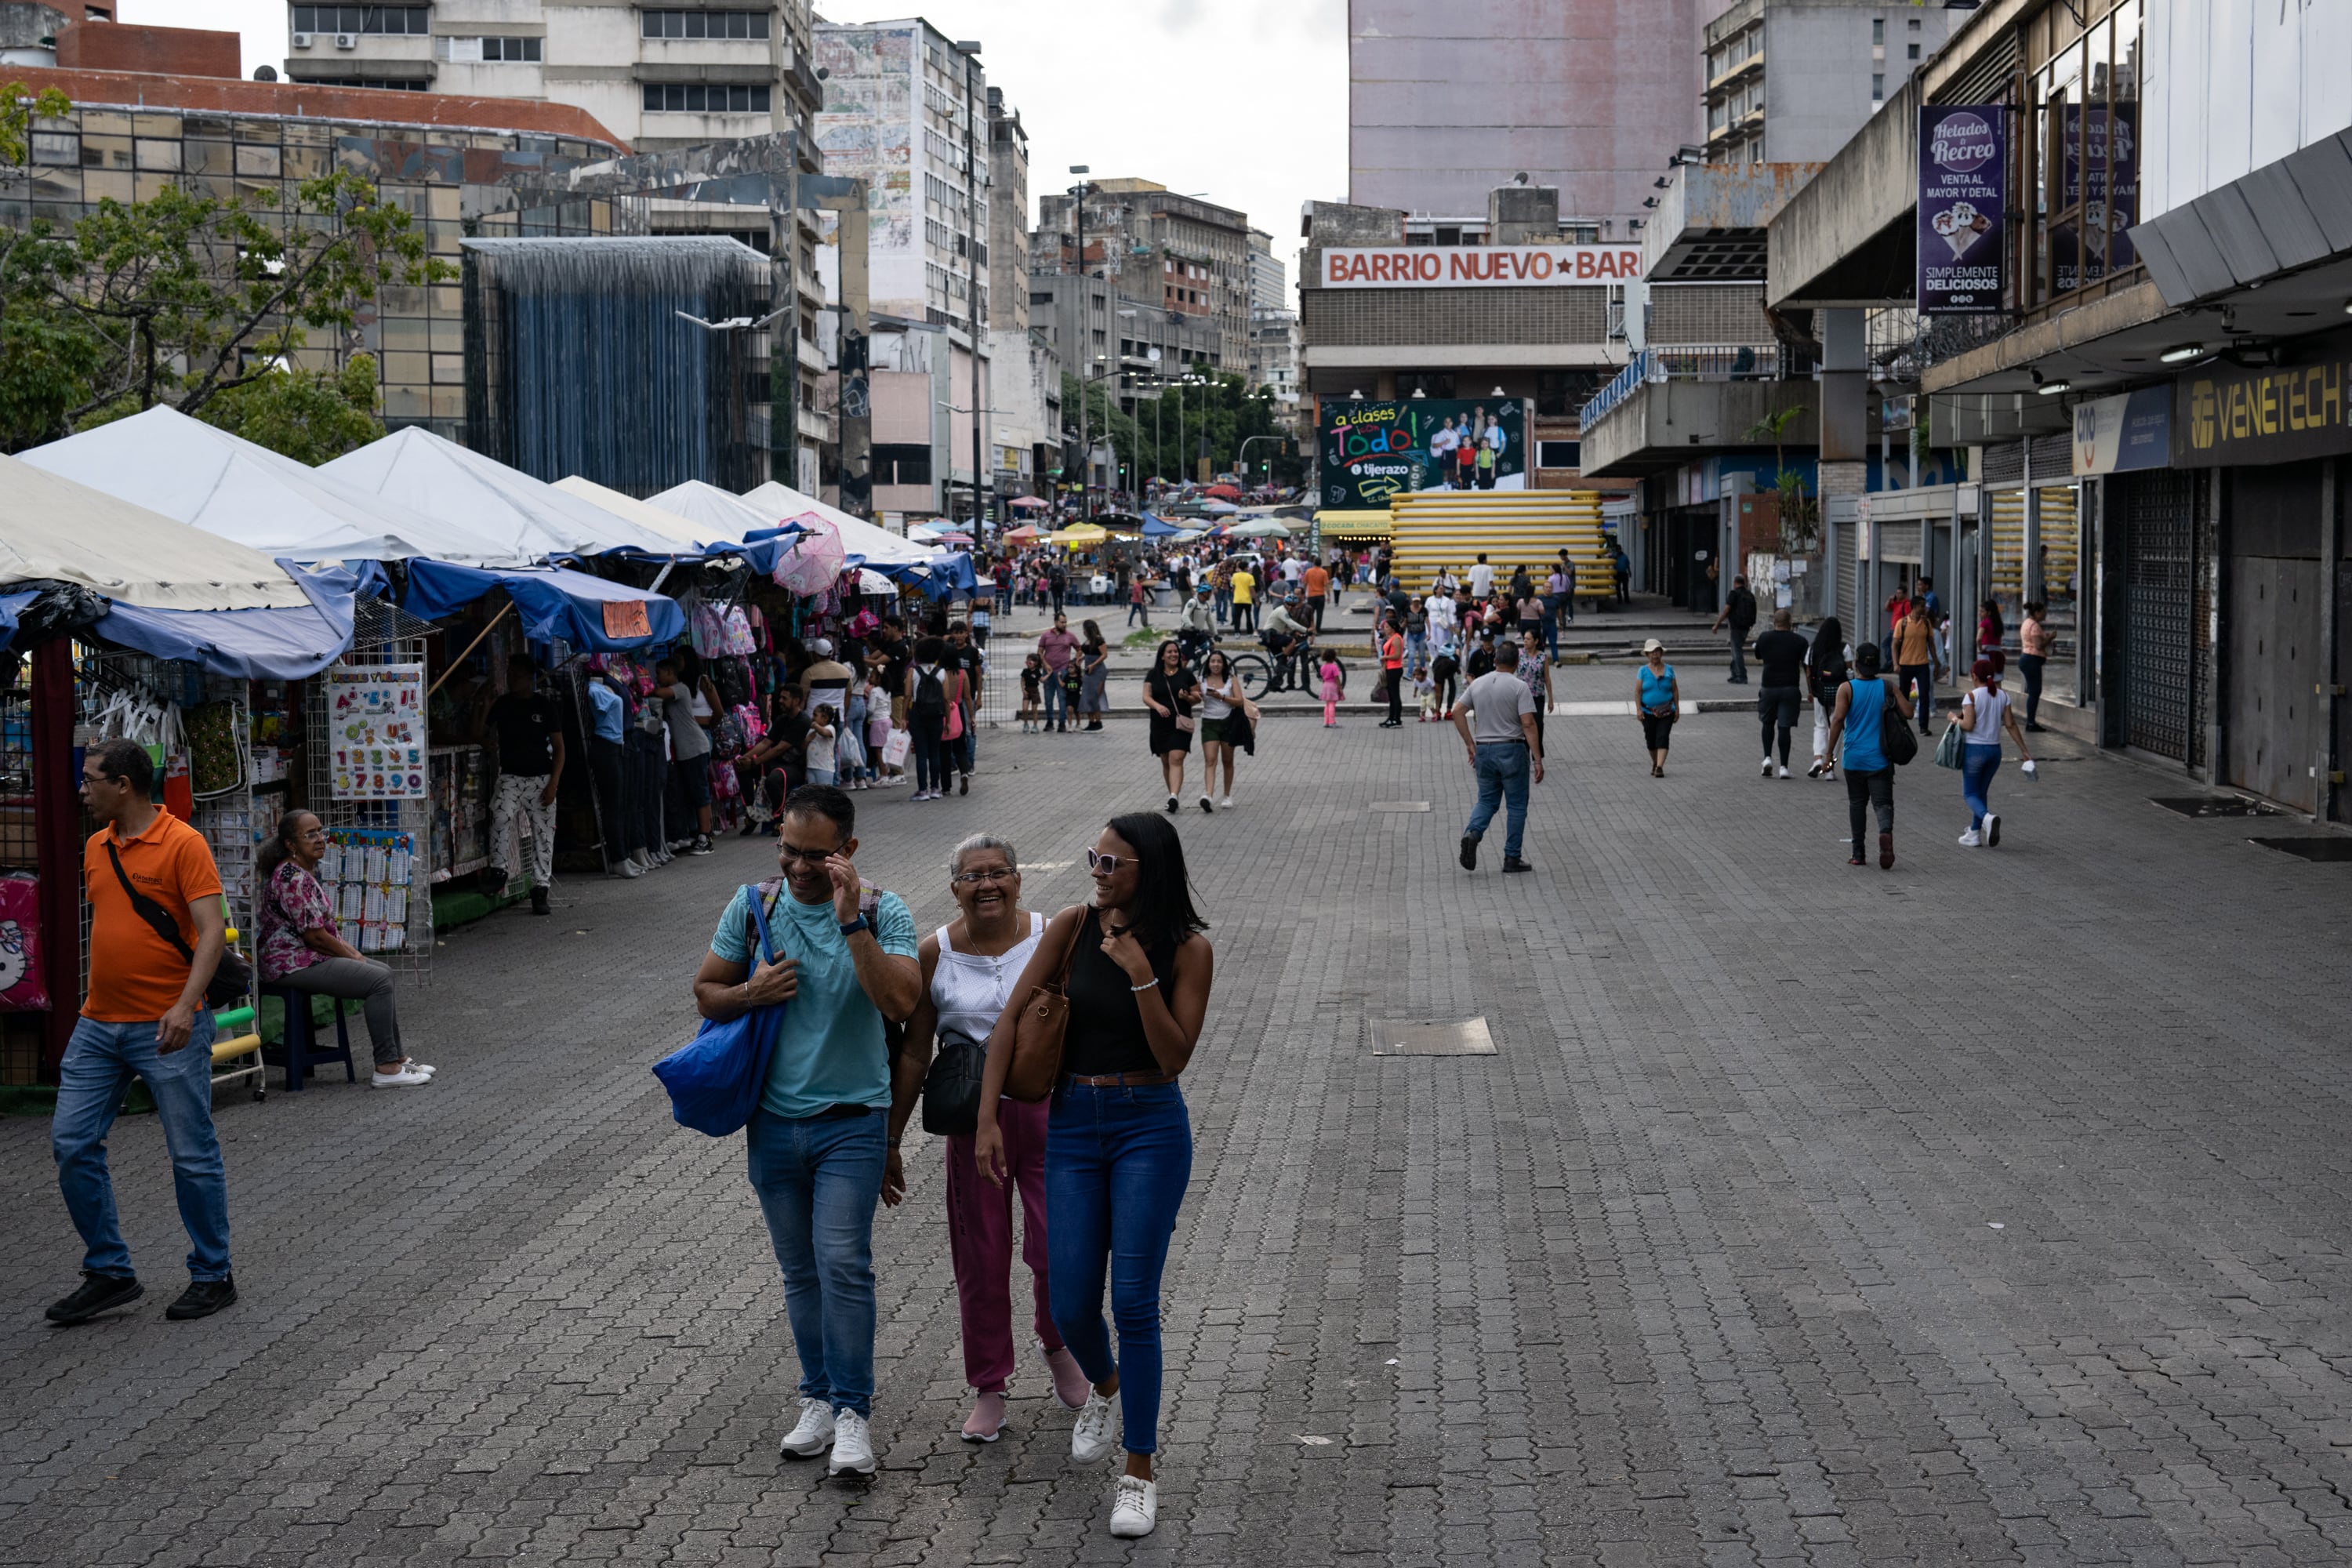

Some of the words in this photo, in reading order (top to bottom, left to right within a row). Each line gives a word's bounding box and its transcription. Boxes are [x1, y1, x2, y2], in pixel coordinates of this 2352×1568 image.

[1933, 123, 1988, 139] Helados
[1930, 140, 1996, 164] Recreo
[1940, 175, 1970, 184] VENTA
[1971, 175, 1984, 184] AL
[1926, 188, 1959, 198] MAYOR
[1960, 188, 1968, 198] Y
[1969, 188, 1998, 198] DETAL
[1329, 253, 1440, 281] BARRIO
[1450, 252, 1552, 280] NUEVO
[1926, 267, 1998, 278] SIMPLEMENTE
[1926, 278, 1998, 290] DELICIOSOS
[2216, 362, 2340, 441] VENETECH
[1335, 416, 1347, 426] a
[1351, 408, 1396, 425] clases
[1363, 463, 1409, 477] tijerazo
[337, 750, 347, 765] 1
[352, 749, 365, 764] 2
[371, 750, 383, 764] 3
[408, 749, 420, 764] 5
[338, 775, 350, 789] 6
[355, 774, 367, 789] 7
[373, 774, 384, 789] 8
[390, 774, 402, 789] 9
